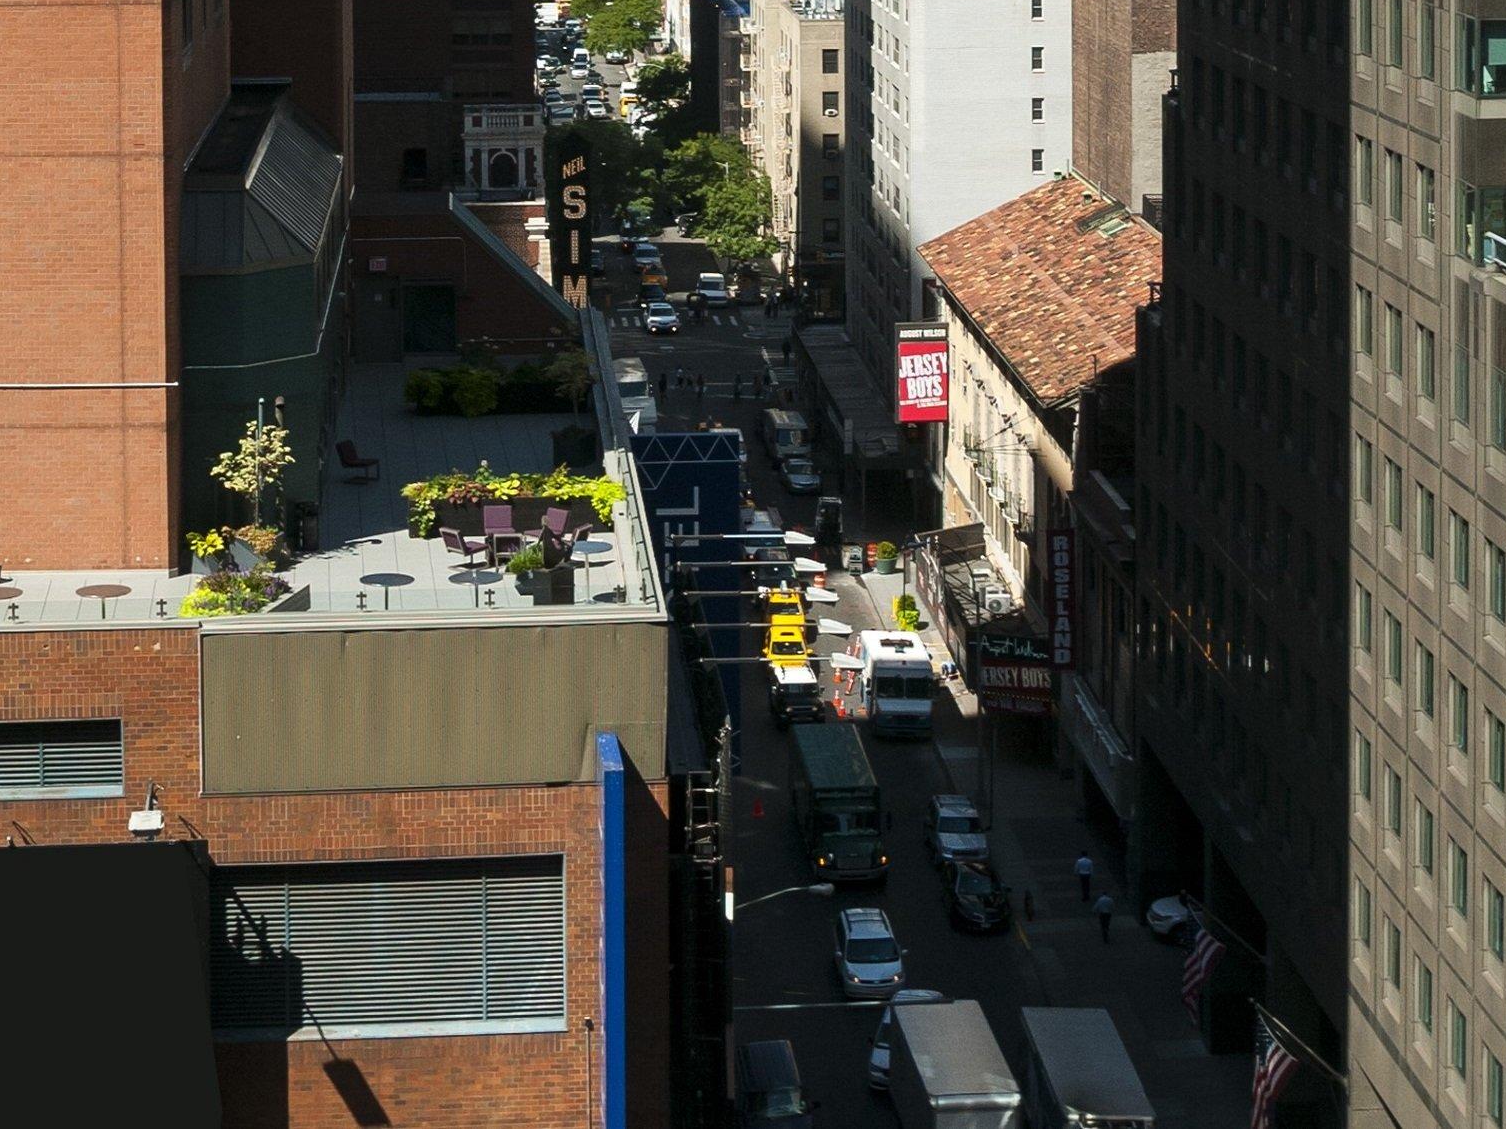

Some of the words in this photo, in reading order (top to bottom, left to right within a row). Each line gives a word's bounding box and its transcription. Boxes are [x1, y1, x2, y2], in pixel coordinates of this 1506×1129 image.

[899, 352, 947, 379] JERSEY
[907, 375, 943, 400] BOYS
[1053, 536, 1072, 664] ROSELAND
[982, 666, 1019, 688] ERSEY
[1021, 667, 1052, 689] BOYS
